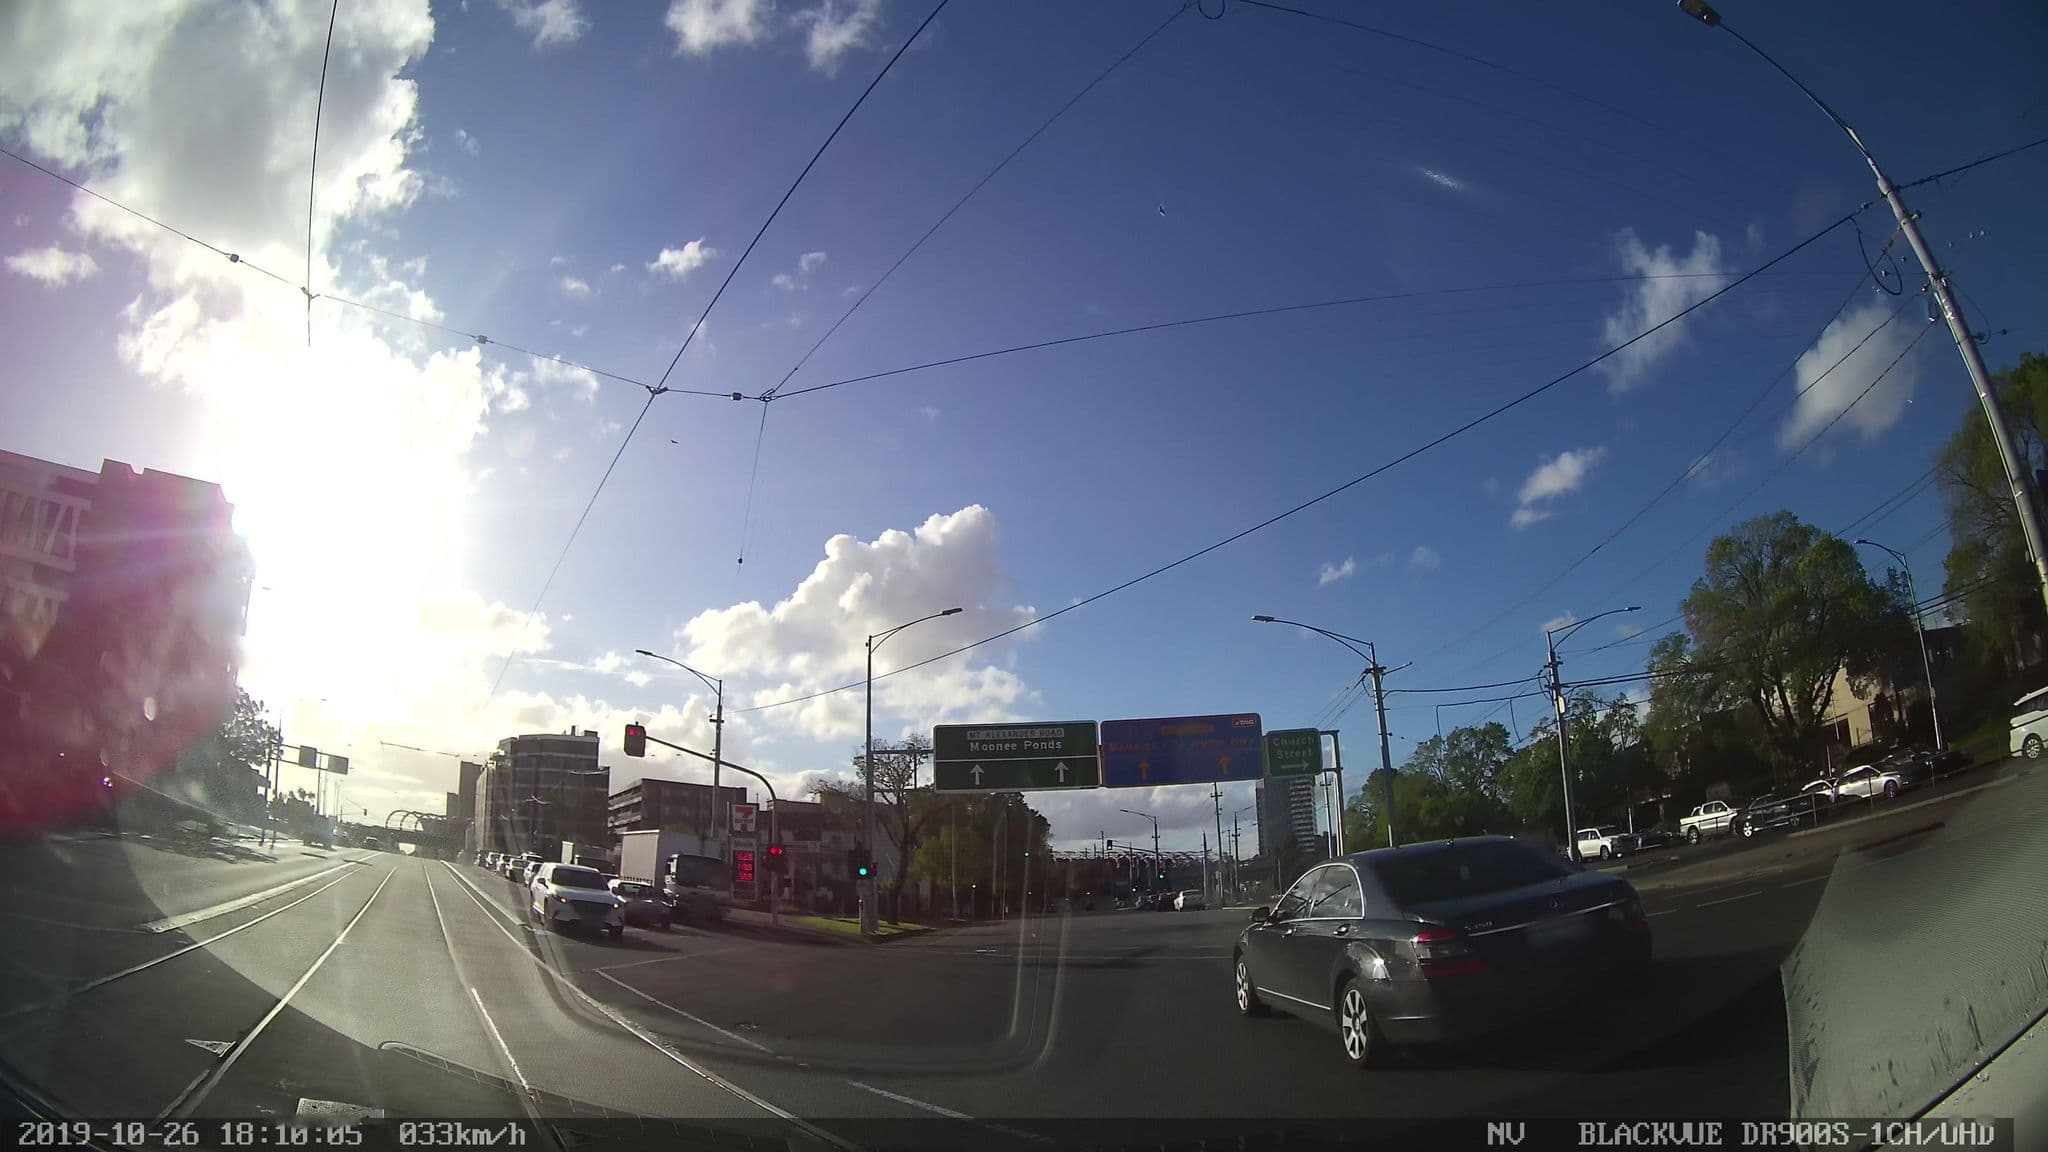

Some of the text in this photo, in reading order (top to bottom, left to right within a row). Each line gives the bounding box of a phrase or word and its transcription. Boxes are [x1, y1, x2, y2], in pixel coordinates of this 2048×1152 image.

[985, 730, 1035, 738] ALEXANDER
[1039, 728, 1063, 737] ROAD
[970, 740, 1062, 751] Moonee Ponds
[1272, 735, 1314, 759] Church Street
